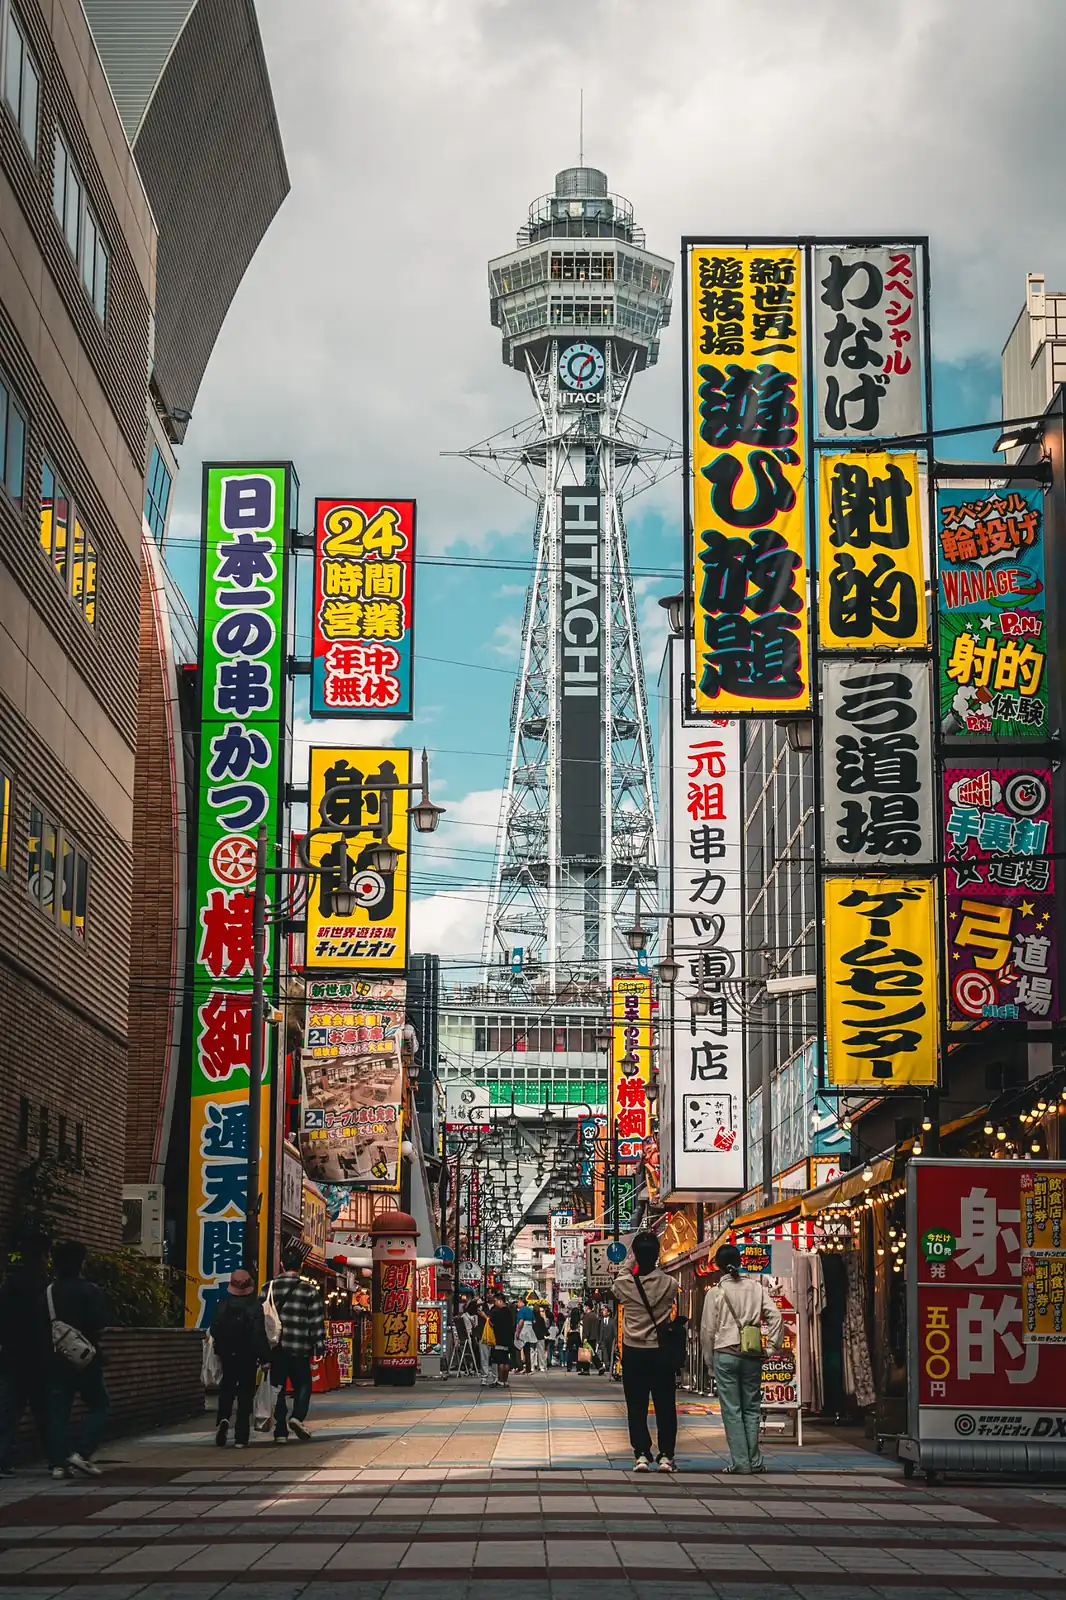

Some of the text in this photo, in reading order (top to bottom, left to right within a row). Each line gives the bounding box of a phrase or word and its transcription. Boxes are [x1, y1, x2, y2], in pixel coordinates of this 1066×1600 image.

[698, 257, 745, 356] 遊技場
[749, 257, 797, 356] 新世界一
[882, 254, 914, 375] スペシャル
[821, 255, 890, 431] わなげ
[697, 364, 805, 699] 遊び放題
[942, 493, 1026, 526] スペシャル
[325, 507, 406, 559] 24
[829, 463, 917, 638] 射的
[940, 510, 1039, 564] 輪投げ
[323, 560, 402, 599] 時間
[564, 496, 599, 697] HITACHI
[941, 569, 1020, 609] WANAGE
[320, 600, 402, 639] 営業
[1000, 612, 1042, 636] PAN!
[209, 474, 276, 830] 日本一の串かつ
[327, 645, 400, 675] 年中
[947, 632, 1045, 697] 射的
[327, 675, 401, 705] 無休
[991, 693, 1045, 727] 体験
[836, 672, 922, 856] 弓道場
[318, 759, 400, 921] 射的
[947, 807, 1049, 856] 手裏剣
[988, 853, 1049, 890] 道場
[315, 941, 396, 957] チャンピオン
[316, 926, 396, 939] 新世界遊技場
[198, 888, 270, 1083] 横綱
[835, 887, 926, 1078] ゲームセンター
[982, 1004, 1019, 1019] NICE!
[617, 1078, 646, 1138] 横綱
[926, 1242, 952, 1256] 10発
[927, 1233, 951, 1243] 今だけ
[930, 1263, 947, 1278] 発
[761, 1361, 794, 1372] sticks
[978, 1417, 1066, 1438] チャンピオン DX
